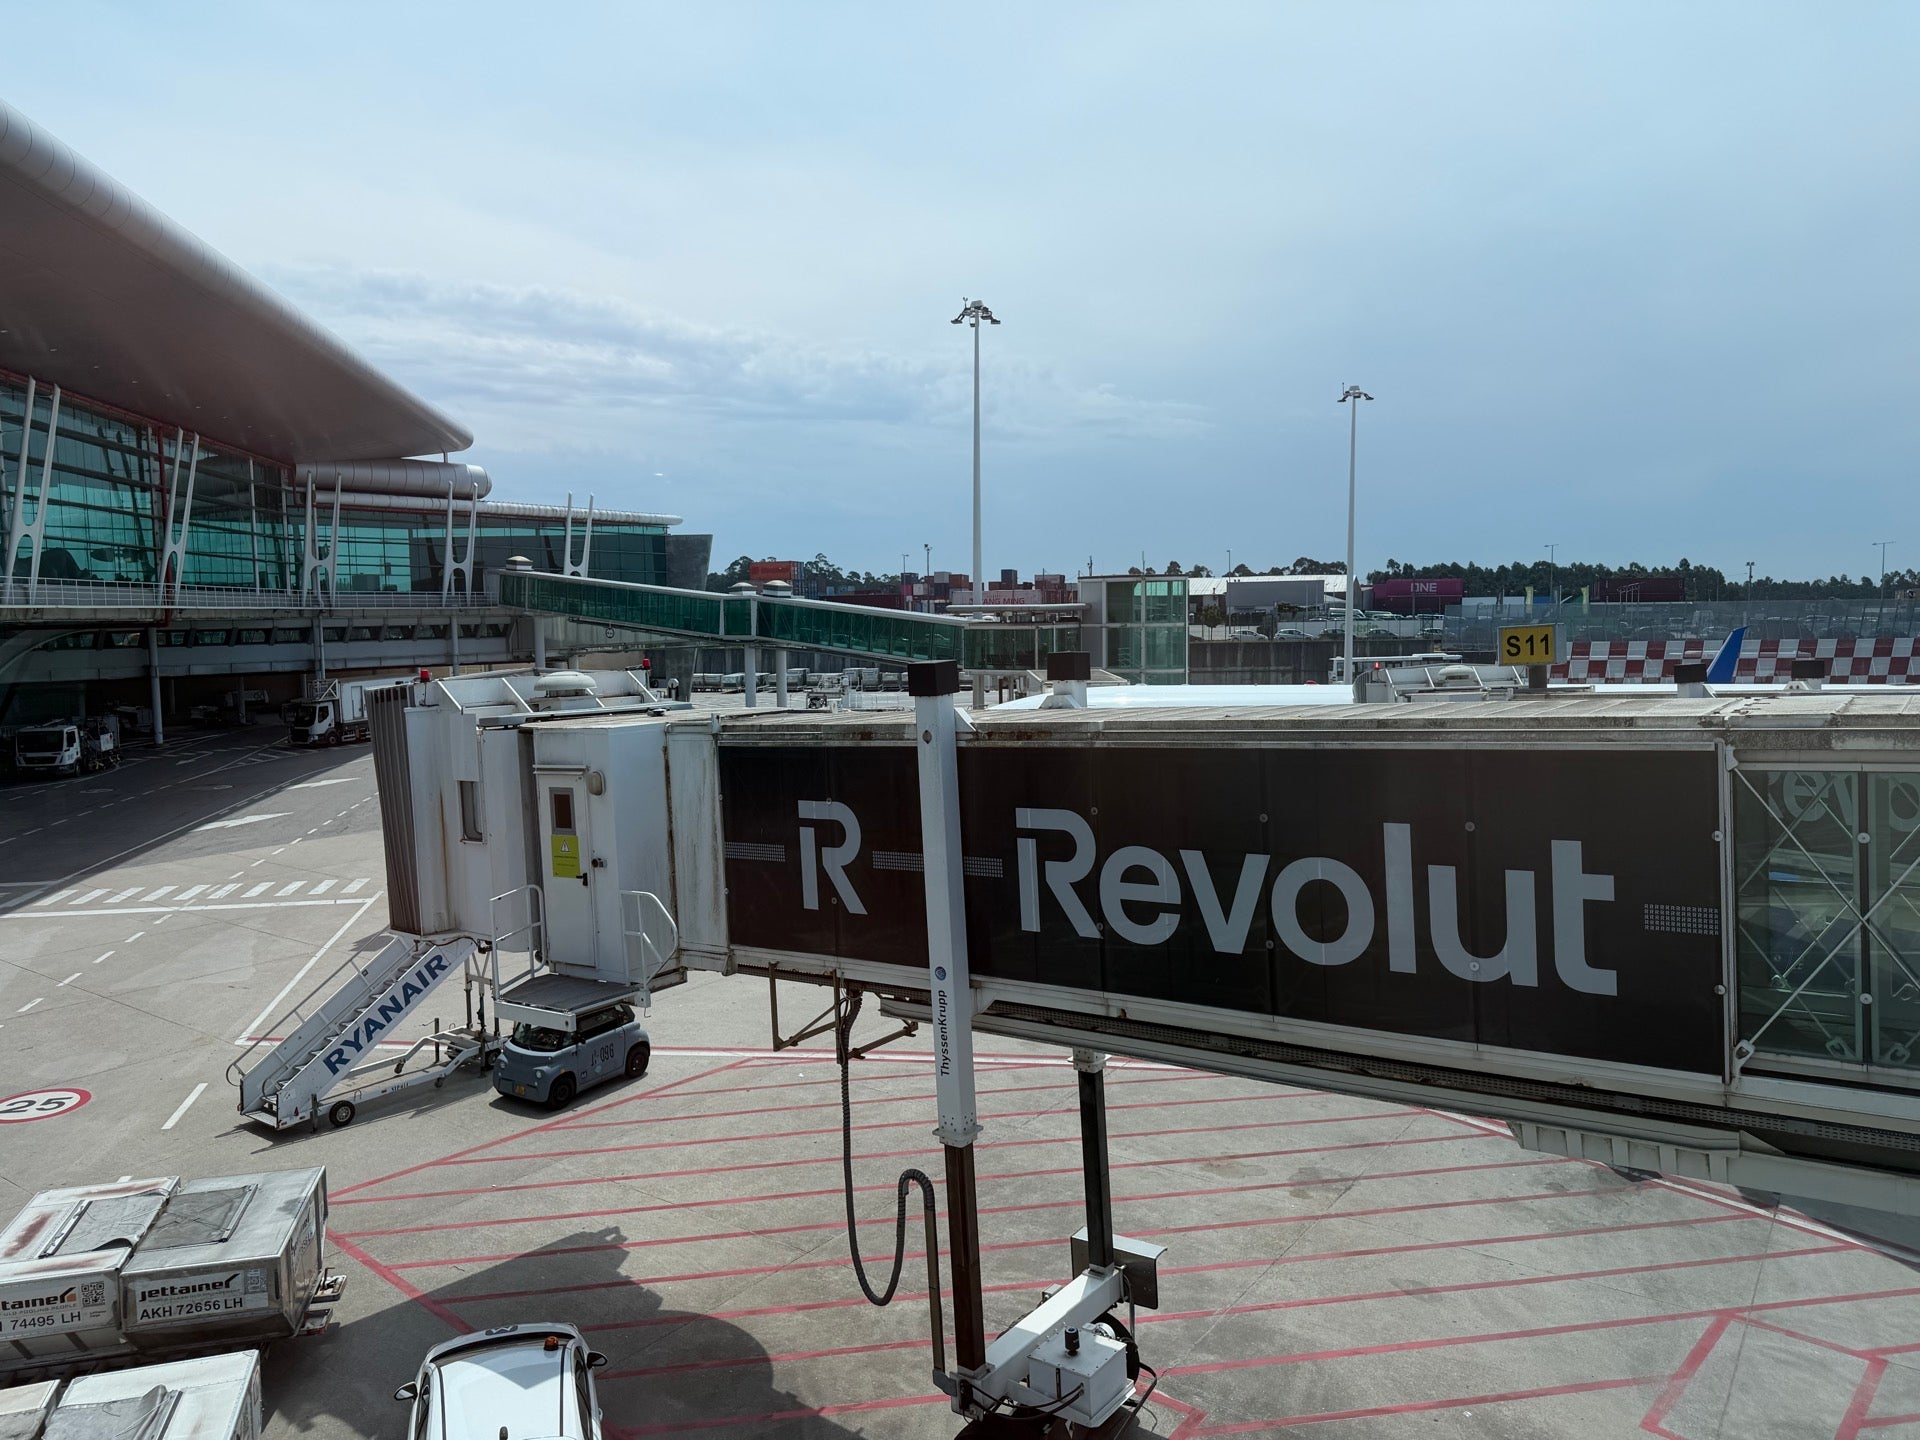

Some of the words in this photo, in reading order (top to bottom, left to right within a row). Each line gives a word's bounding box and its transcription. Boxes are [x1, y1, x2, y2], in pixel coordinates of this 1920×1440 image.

[1410, 582, 1437, 593] ONE
[1506, 633, 1549, 657] S11
[798, 800, 868, 915] R
[1015, 807, 1617, 996] Revolut
[322, 954, 448, 1076] RYANAIR
[938, 990, 951, 1076] ThyssenKrupp
[0, 1096, 73, 1113] 25
[10, 1315, 55, 1330] 74495
[61, 1311, 81, 1324] LH
[140, 1305, 172, 1320] AKH
[176, 1300, 221, 1315] 72656
[224, 1297, 243, 1309] LH
